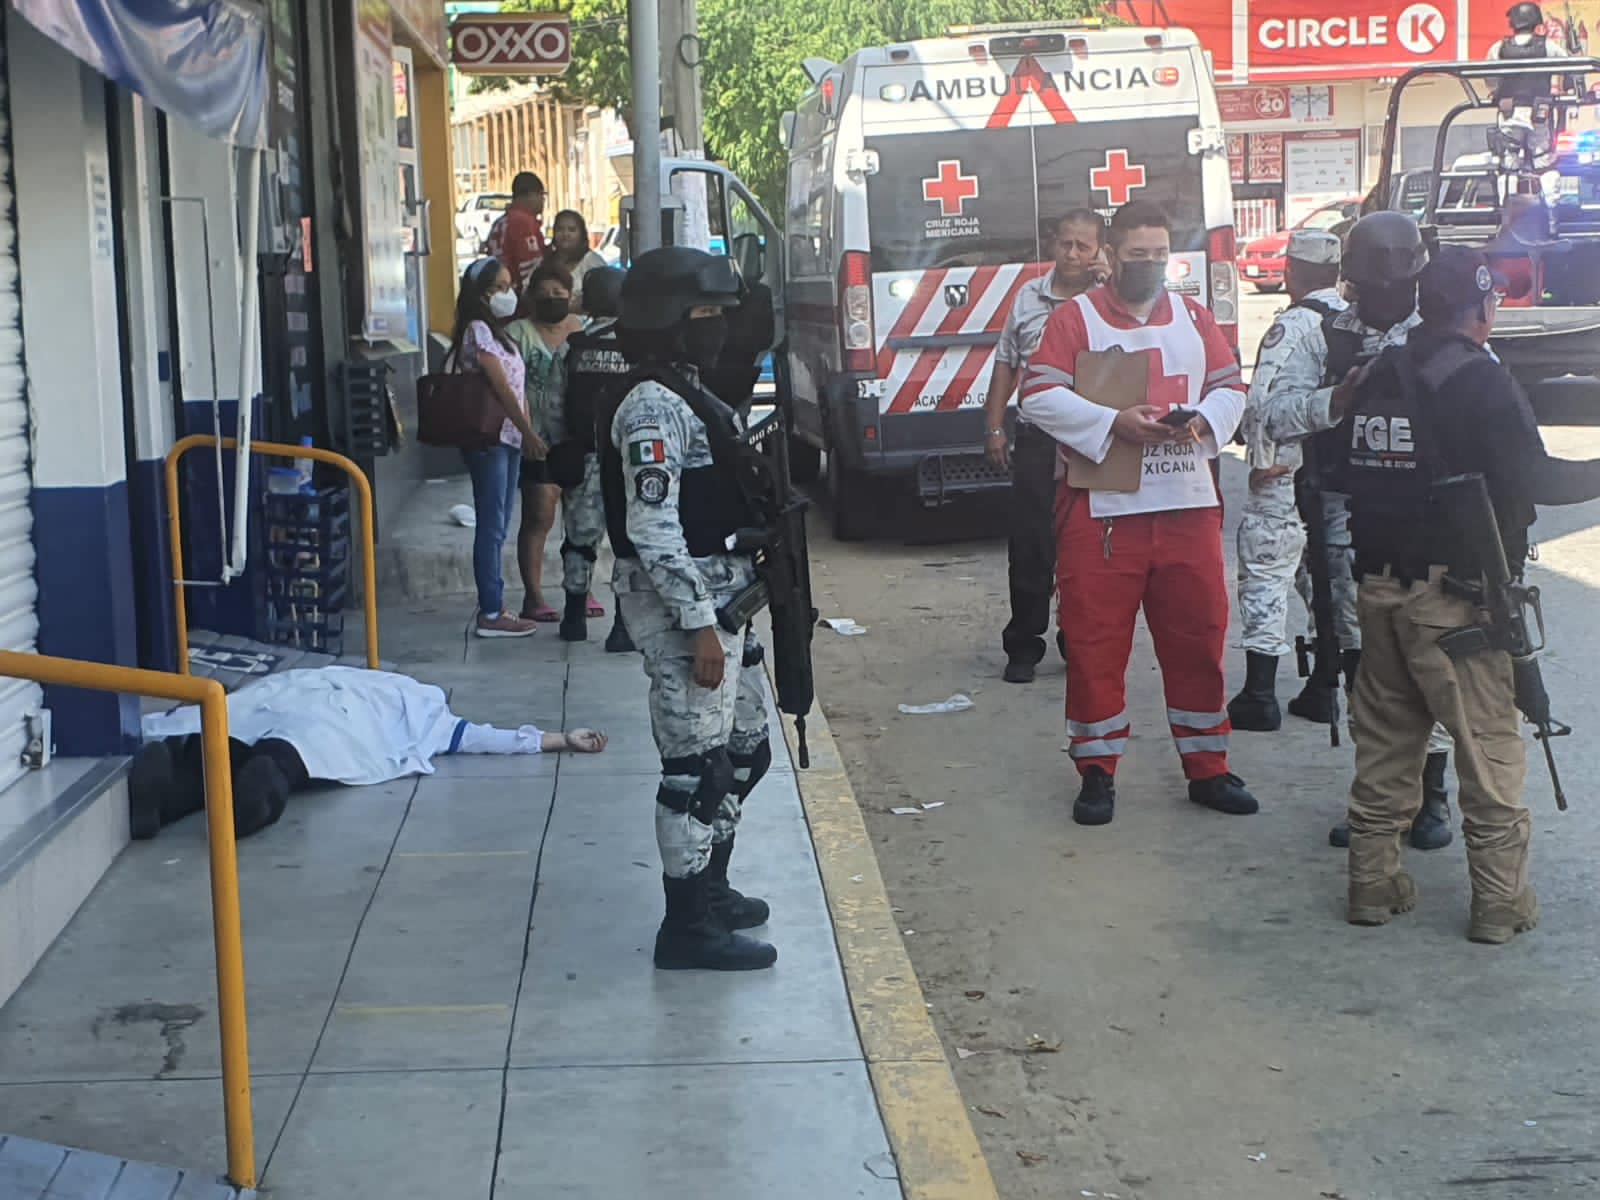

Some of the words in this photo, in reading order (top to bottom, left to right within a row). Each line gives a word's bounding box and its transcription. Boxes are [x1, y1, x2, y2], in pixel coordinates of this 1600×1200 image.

[456, 22, 566, 64] OXXO
[1258, 15, 1388, 49] CIRCLE
[1409, 13, 1442, 50] K
[909, 66, 1150, 102] AMBULANCIA
[925, 218, 951, 229] CRUZ
[954, 216, 980, 227] ROJA
[925, 226, 981, 238] MEXICANA
[1351, 415, 1416, 453] FGE
[1163, 443, 1195, 457] ROJA
[1144, 461, 1196, 476] XICANA
